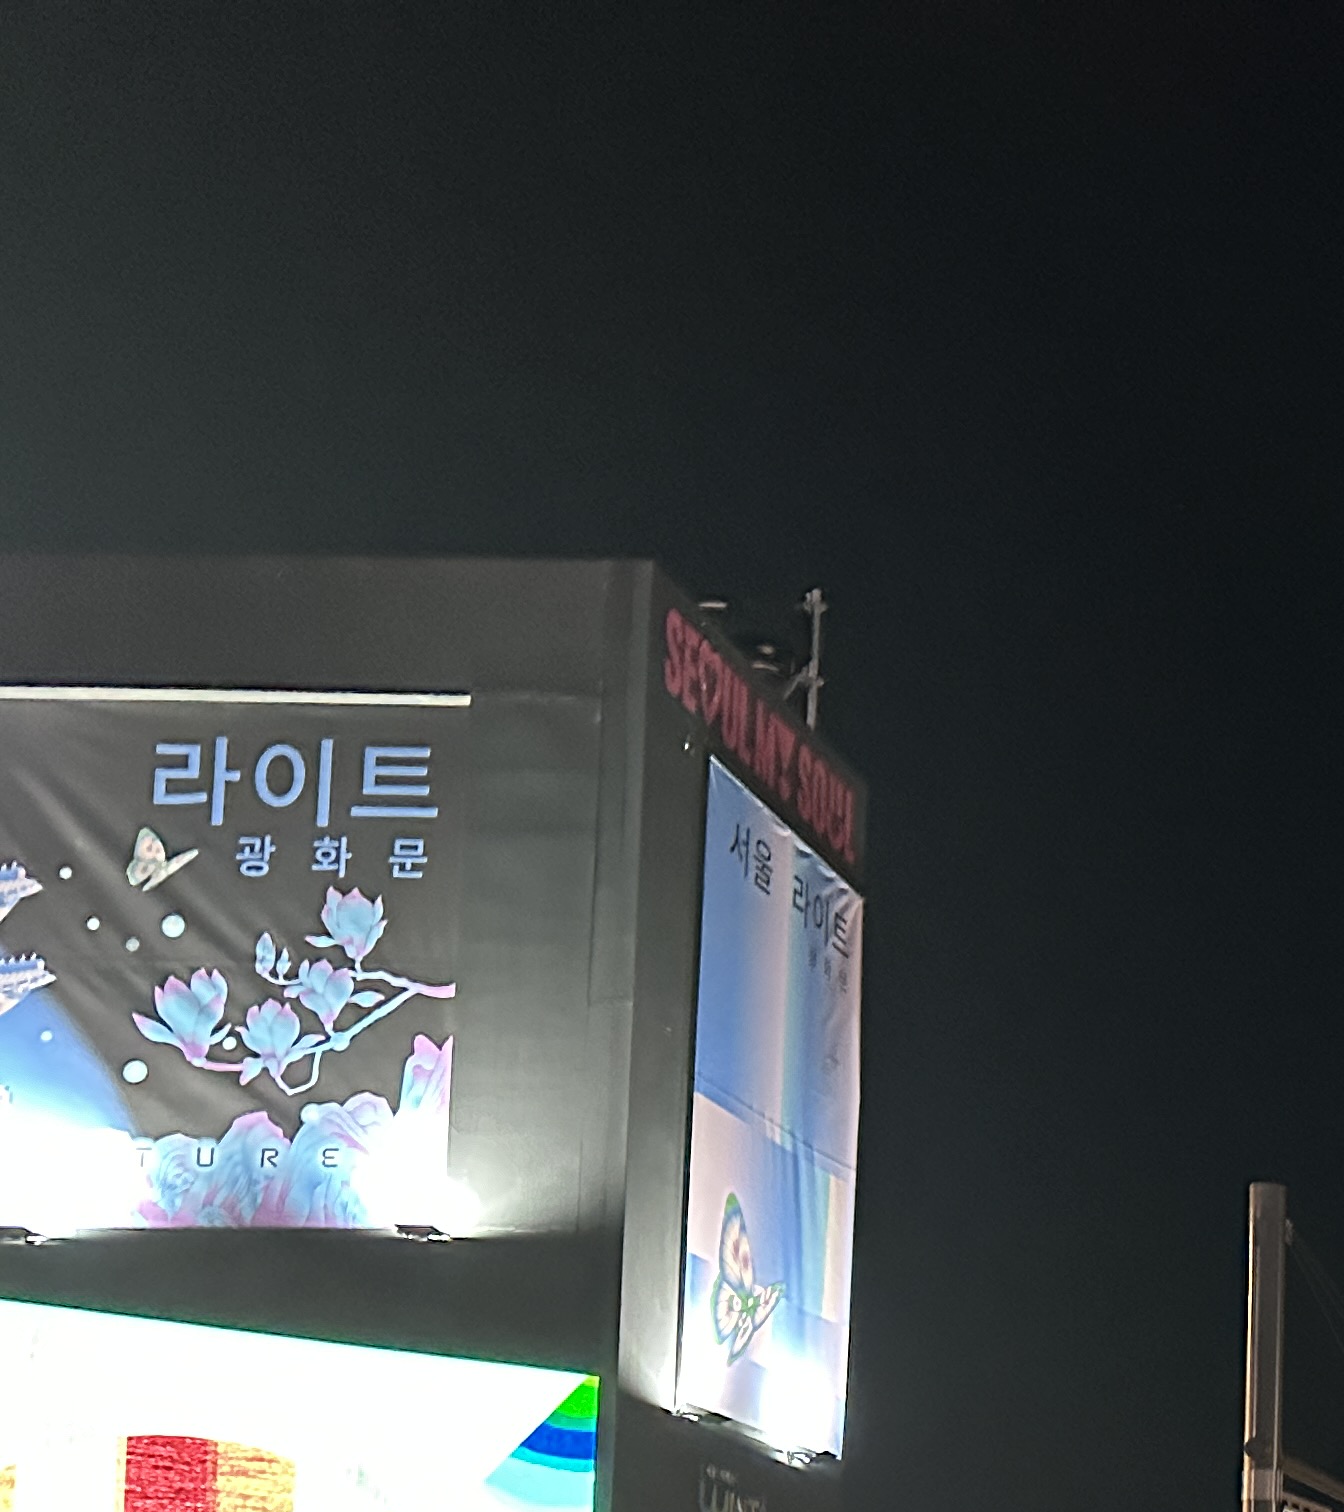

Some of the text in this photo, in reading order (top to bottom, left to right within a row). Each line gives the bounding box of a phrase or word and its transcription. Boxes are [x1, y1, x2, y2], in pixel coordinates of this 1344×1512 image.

[664, 607, 753, 768] SEOUL
[153, 736, 438, 827] 라이트
[730, 823, 850, 959] 서울 라이트
